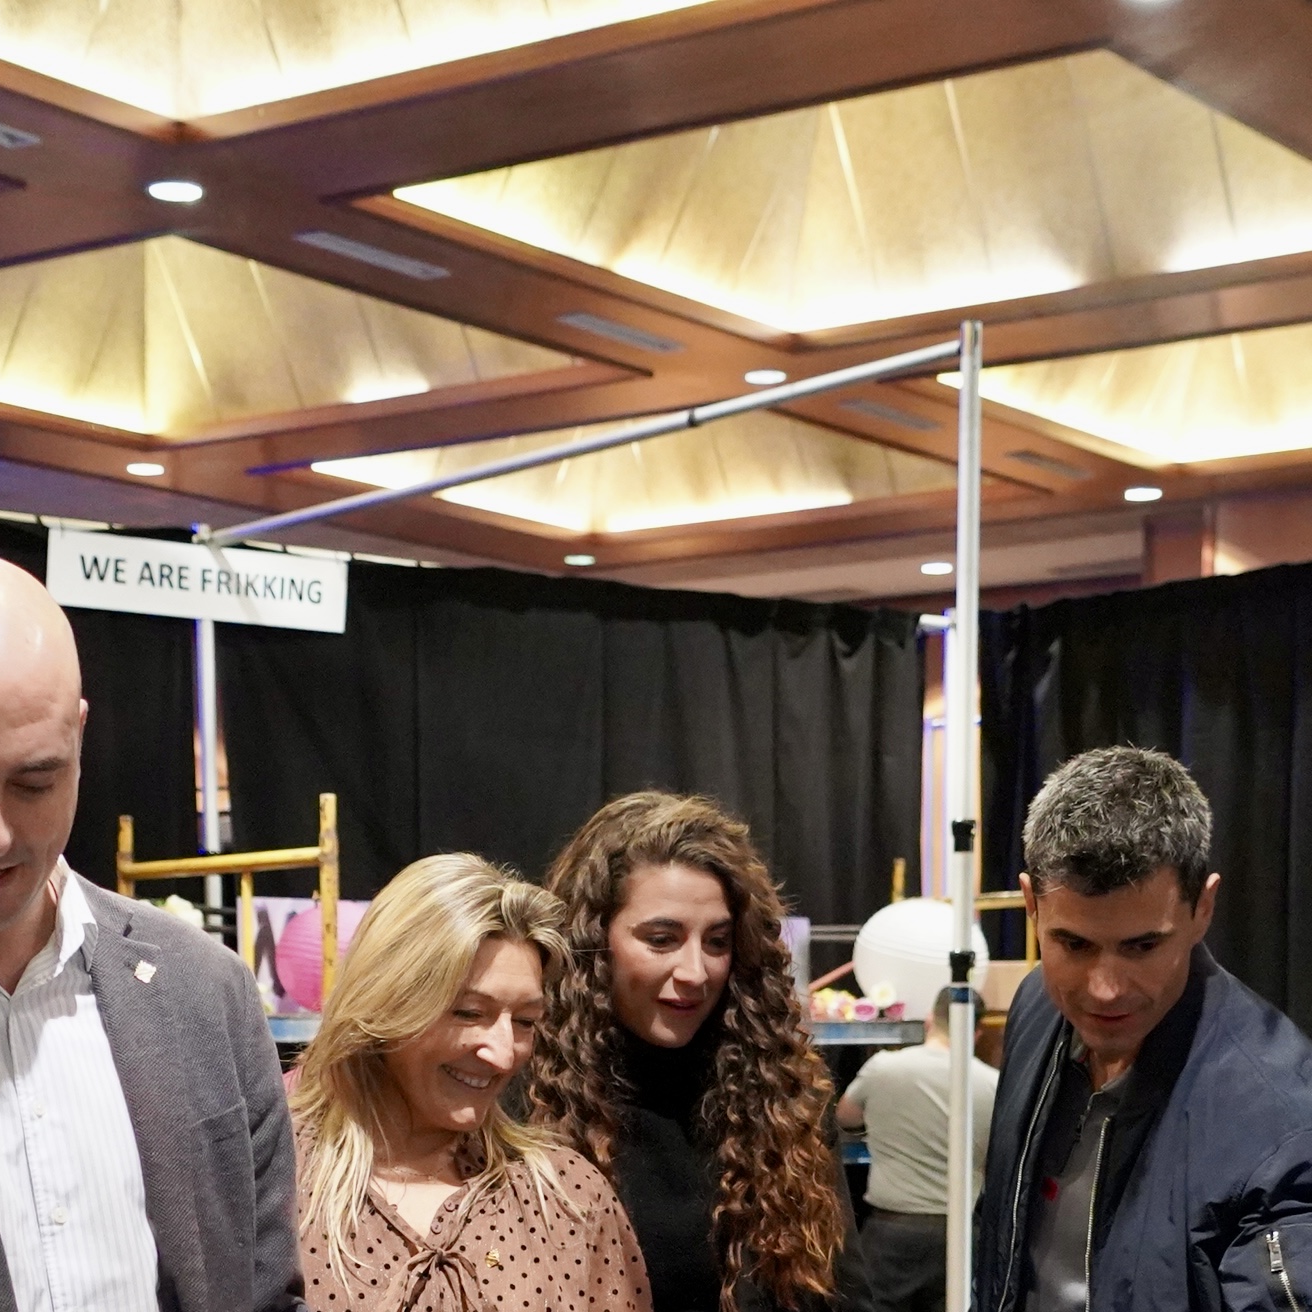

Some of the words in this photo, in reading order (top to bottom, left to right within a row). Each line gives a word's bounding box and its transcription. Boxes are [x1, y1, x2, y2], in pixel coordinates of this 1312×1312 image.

[79, 554, 126, 585] WE
[138, 561, 190, 592] ARE
[201, 568, 323, 605] FRIKKING
